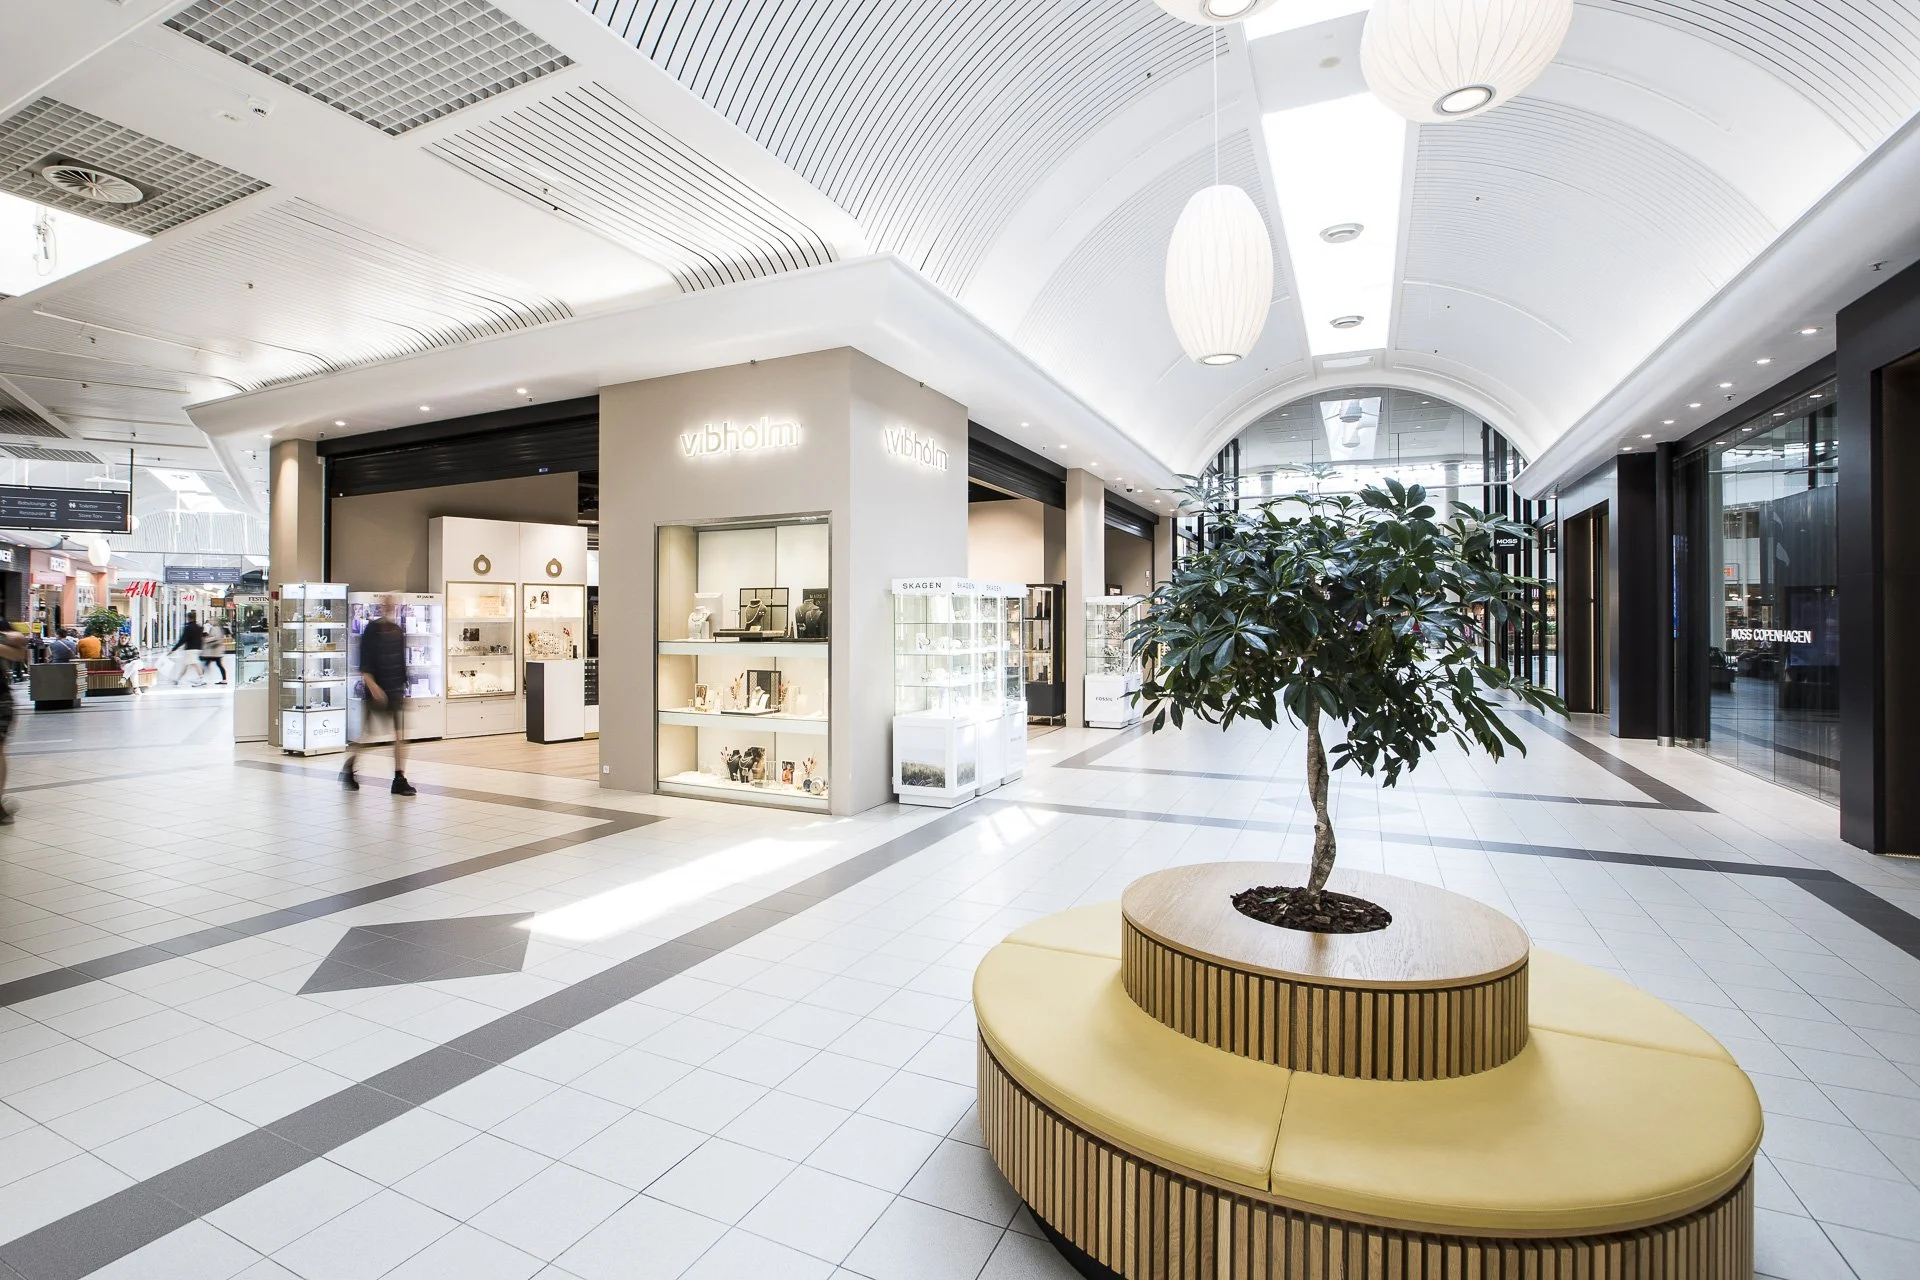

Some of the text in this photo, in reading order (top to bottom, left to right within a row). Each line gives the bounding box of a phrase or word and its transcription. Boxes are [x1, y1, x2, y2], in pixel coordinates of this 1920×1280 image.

[680, 417, 799, 457] vibholm
[885, 427, 948, 471] vibholm
[124, 581, 157, 598] H&M
[1731, 628, 1811, 643] MOSS COPENHAGEN
